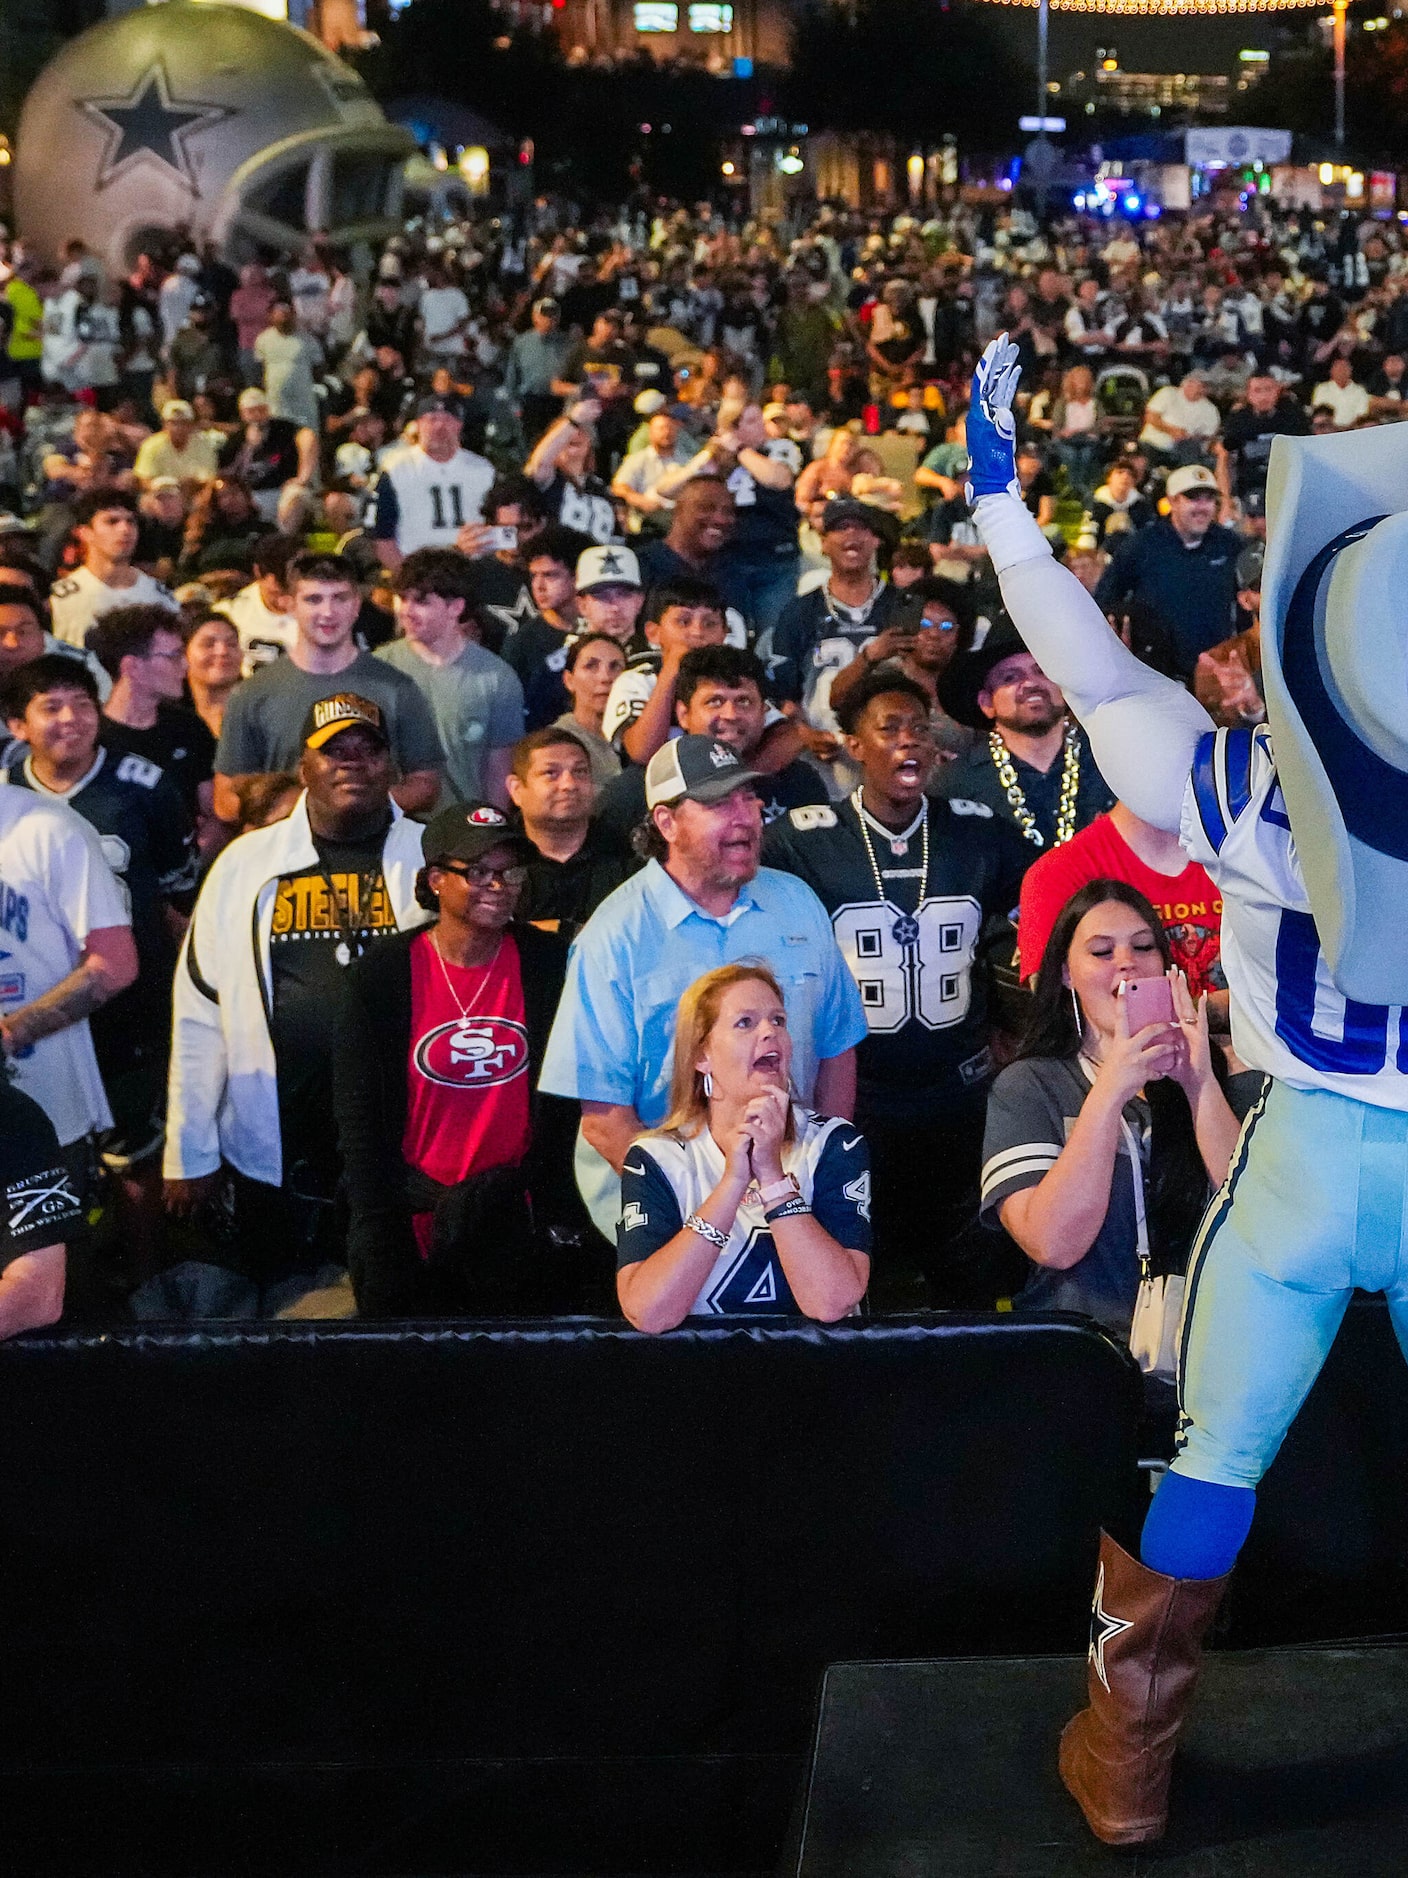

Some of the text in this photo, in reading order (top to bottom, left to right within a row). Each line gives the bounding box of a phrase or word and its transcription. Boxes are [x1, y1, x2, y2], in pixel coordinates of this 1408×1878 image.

[428, 484, 466, 529] 11
[830, 895, 982, 1034] 88
[449, 1028, 516, 1079] SF
